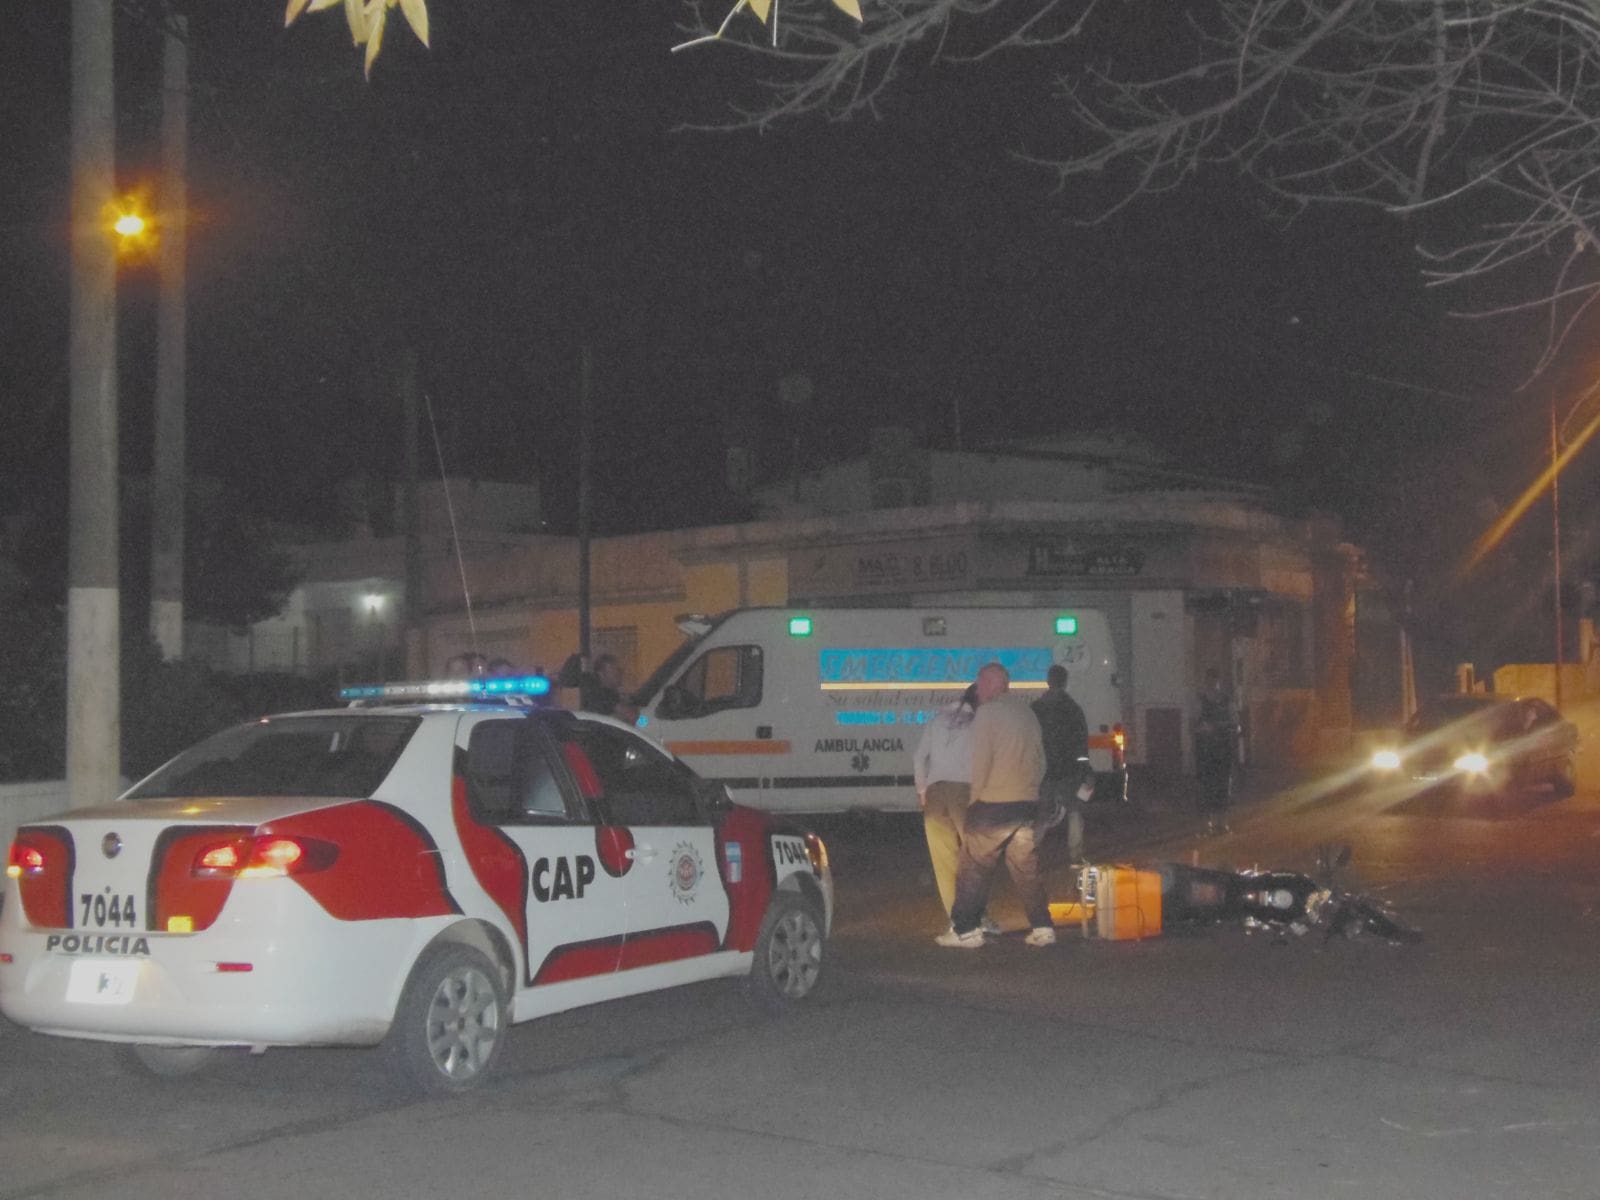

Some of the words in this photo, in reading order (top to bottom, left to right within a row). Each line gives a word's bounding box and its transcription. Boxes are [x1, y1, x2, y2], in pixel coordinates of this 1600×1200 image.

[814, 738, 903, 753] AMBULANCIA
[531, 854, 595, 902] CAP
[81, 893, 136, 929] 7044
[46, 935, 151, 955] POLICIA
